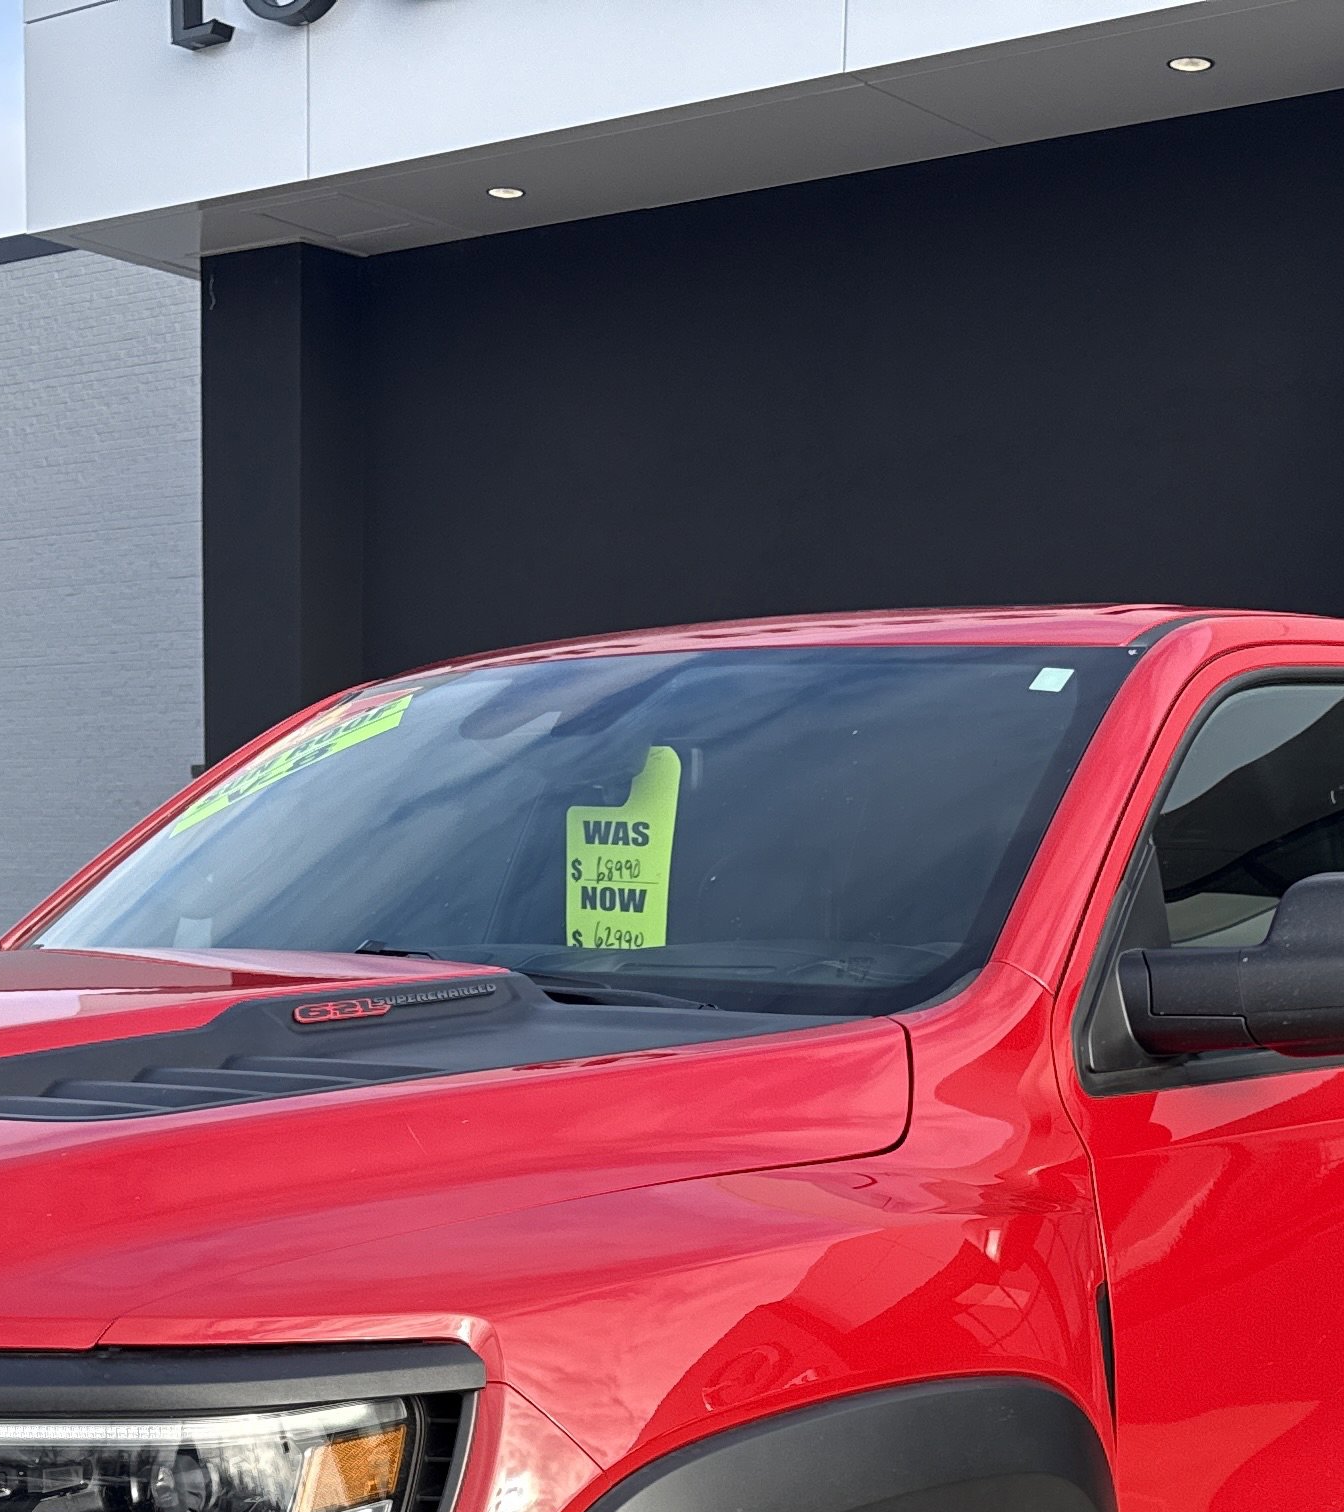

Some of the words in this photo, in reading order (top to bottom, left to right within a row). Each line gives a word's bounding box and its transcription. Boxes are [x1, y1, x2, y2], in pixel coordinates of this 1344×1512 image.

[582, 820, 650, 847] WAS
[571, 858, 583, 881] $
[581, 886, 647, 913] NOW
[594, 921, 645, 949] 62990
[294, 998, 391, 1024] 6.2L
[372, 983, 497, 1006] SUPERCHARGED
